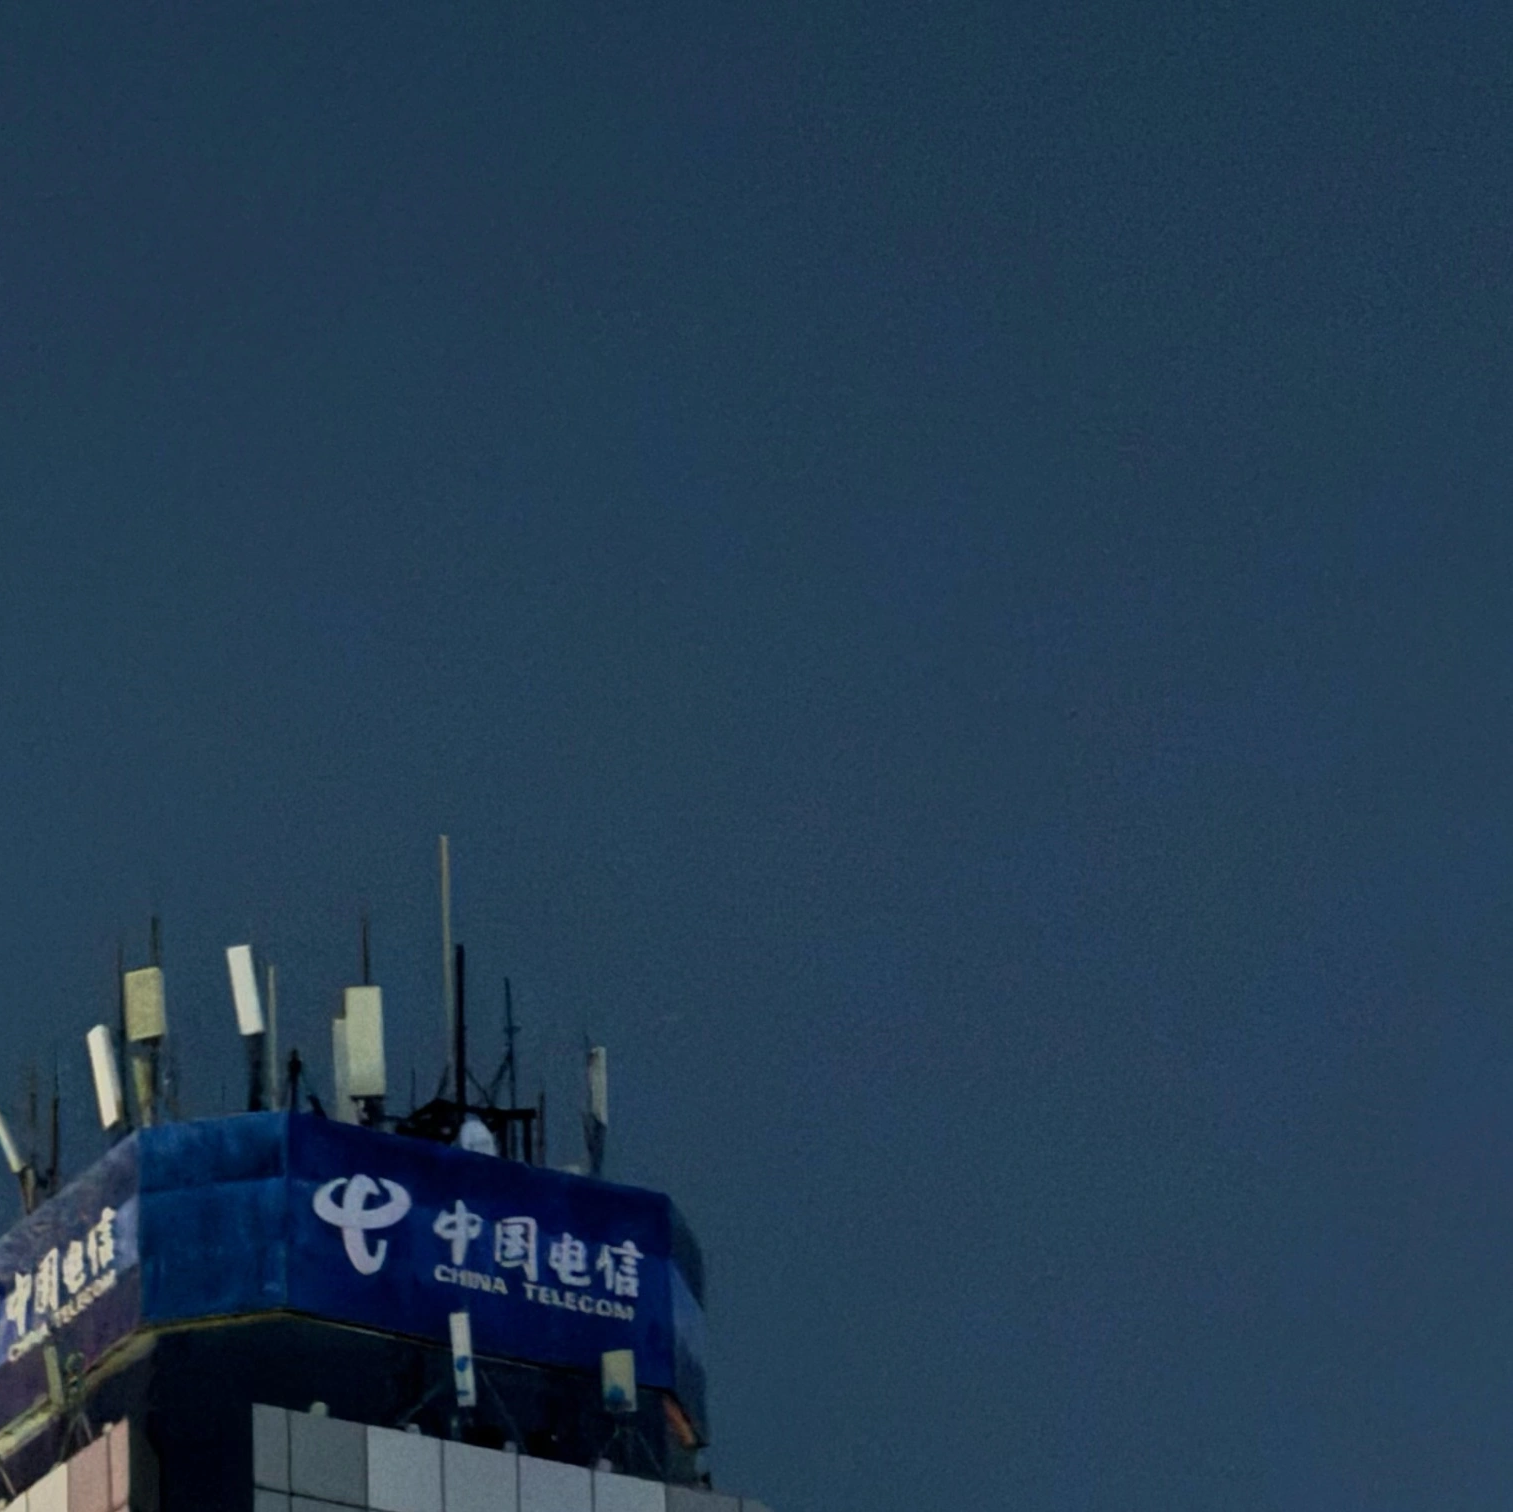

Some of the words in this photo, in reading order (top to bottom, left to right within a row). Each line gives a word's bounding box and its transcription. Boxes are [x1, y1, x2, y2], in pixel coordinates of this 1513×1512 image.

[432, 1199, 644, 1298] 中国电信
[434, 1264, 508, 1295] CHINA
[522, 1282, 635, 1321] TELECOM
